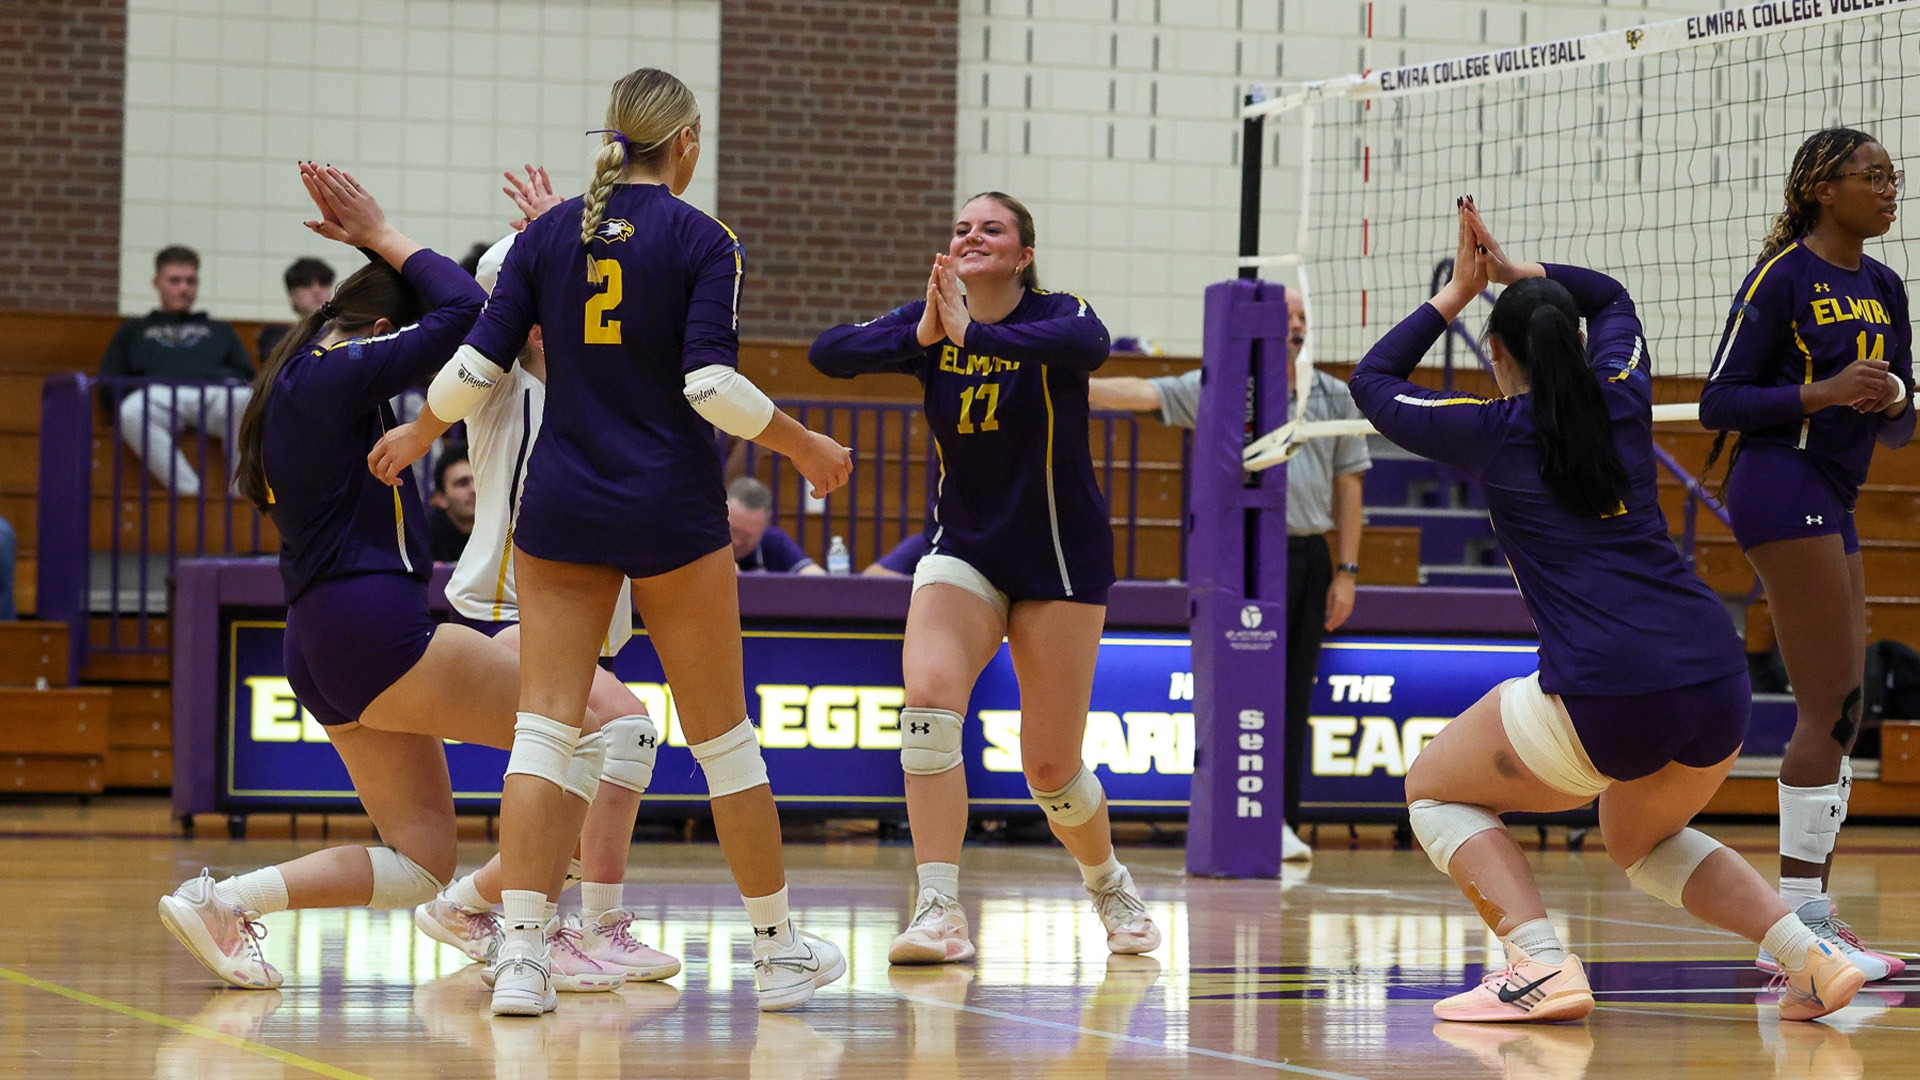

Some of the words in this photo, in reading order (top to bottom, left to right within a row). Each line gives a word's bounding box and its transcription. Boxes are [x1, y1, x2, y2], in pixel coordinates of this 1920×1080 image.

[1687, 9, 1747, 40] ELMIRA
[1753, 0, 1823, 28] COLLEGE
[1381, 65, 1430, 91] ELMIRA
[1434, 54, 1490, 84] COLLEGE
[1494, 39, 1586, 74] VOLLEYBALL
[585, 259, 622, 344] 2
[1810, 296, 1891, 326] ELMIR
[1856, 330, 1884, 361] 14
[957, 383, 1000, 434] 17
[1328, 674, 1395, 703] THE
[978, 709, 1196, 775] SARI
[1307, 715, 1457, 777] EAG
[1237, 709, 1265, 818] Senoh
